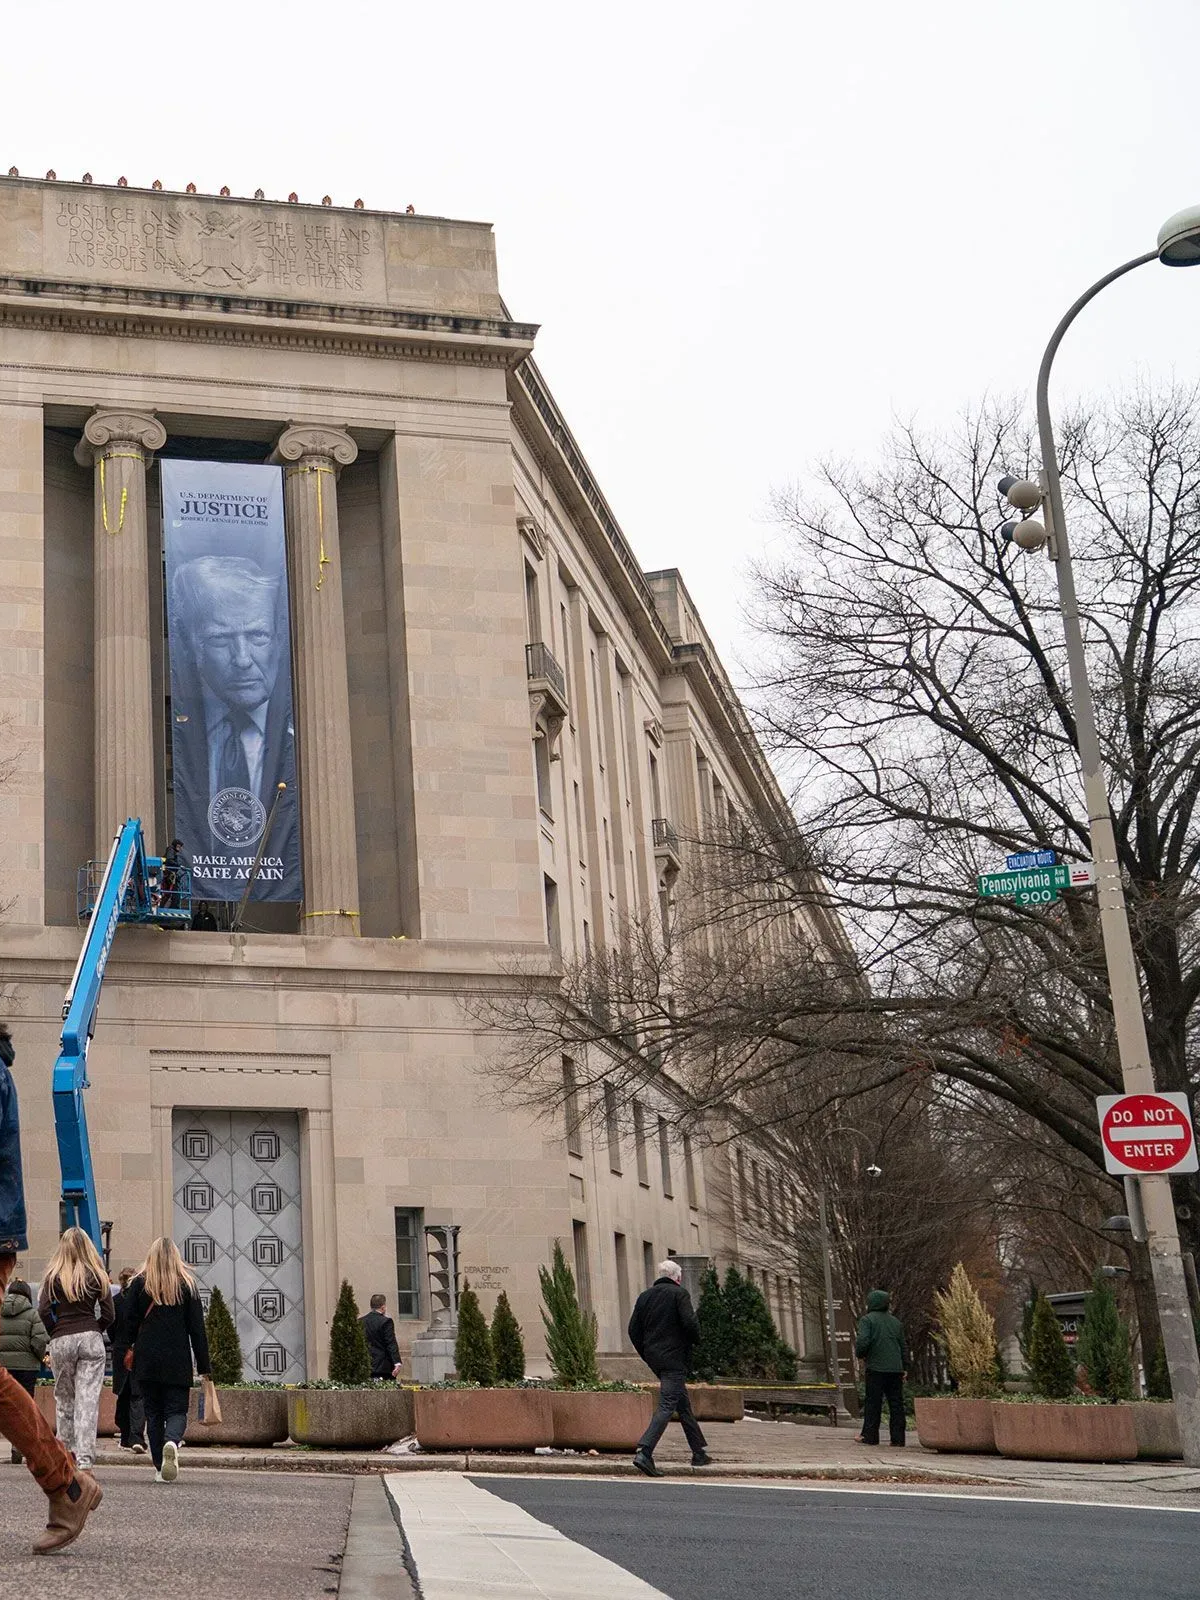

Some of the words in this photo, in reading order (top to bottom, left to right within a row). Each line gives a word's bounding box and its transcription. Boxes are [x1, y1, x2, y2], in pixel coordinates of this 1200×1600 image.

[56, 203, 135, 221] JUSTICE
[144, 210, 163, 223] IN
[264, 222, 293, 235] THE
[304, 225, 331, 239] LIFE
[340, 228, 371, 242] AND
[56, 215, 136, 233] CONDUCT
[142, 223, 164, 238] OF
[268, 234, 297, 248] THE
[305, 238, 349, 253] STATE
[356, 241, 370, 254] IS
[69, 228, 165, 249] POSSIBLE
[262, 246, 299, 260] ONLY
[304, 250, 321, 262] AS
[327, 252, 361, 266] FIRST
[69, 241, 80, 253] IT
[87, 243, 146, 259] RESIDES
[152, 249, 167, 261] IN
[268, 259, 297, 273] THE
[307, 262, 362, 279] HEARTS
[67, 253, 95, 267] AND
[101, 257, 148, 272] SOULS
[154, 261, 170, 274] OF
[264, 271, 291, 285] THE
[296, 275, 363, 291] CITIZENS
[198, 493, 255, 502] DEPARTMENT
[180, 501, 269, 519] JUSTICE
[192, 855, 227, 866] MAKE
[192, 866, 234, 880] SAFE
[982, 869, 1051, 893] Pennsylvania
[1054, 868, 1065, 876] Ave
[1054, 876, 1065, 885] NW
[1020, 890, 1051, 904] 900
[1112, 1110, 1133, 1123] DO
[1143, 1109, 1174, 1122] NOT
[1124, 1144, 1175, 1157] ENTER
[474, 1281, 502, 1289] JUSTICE
